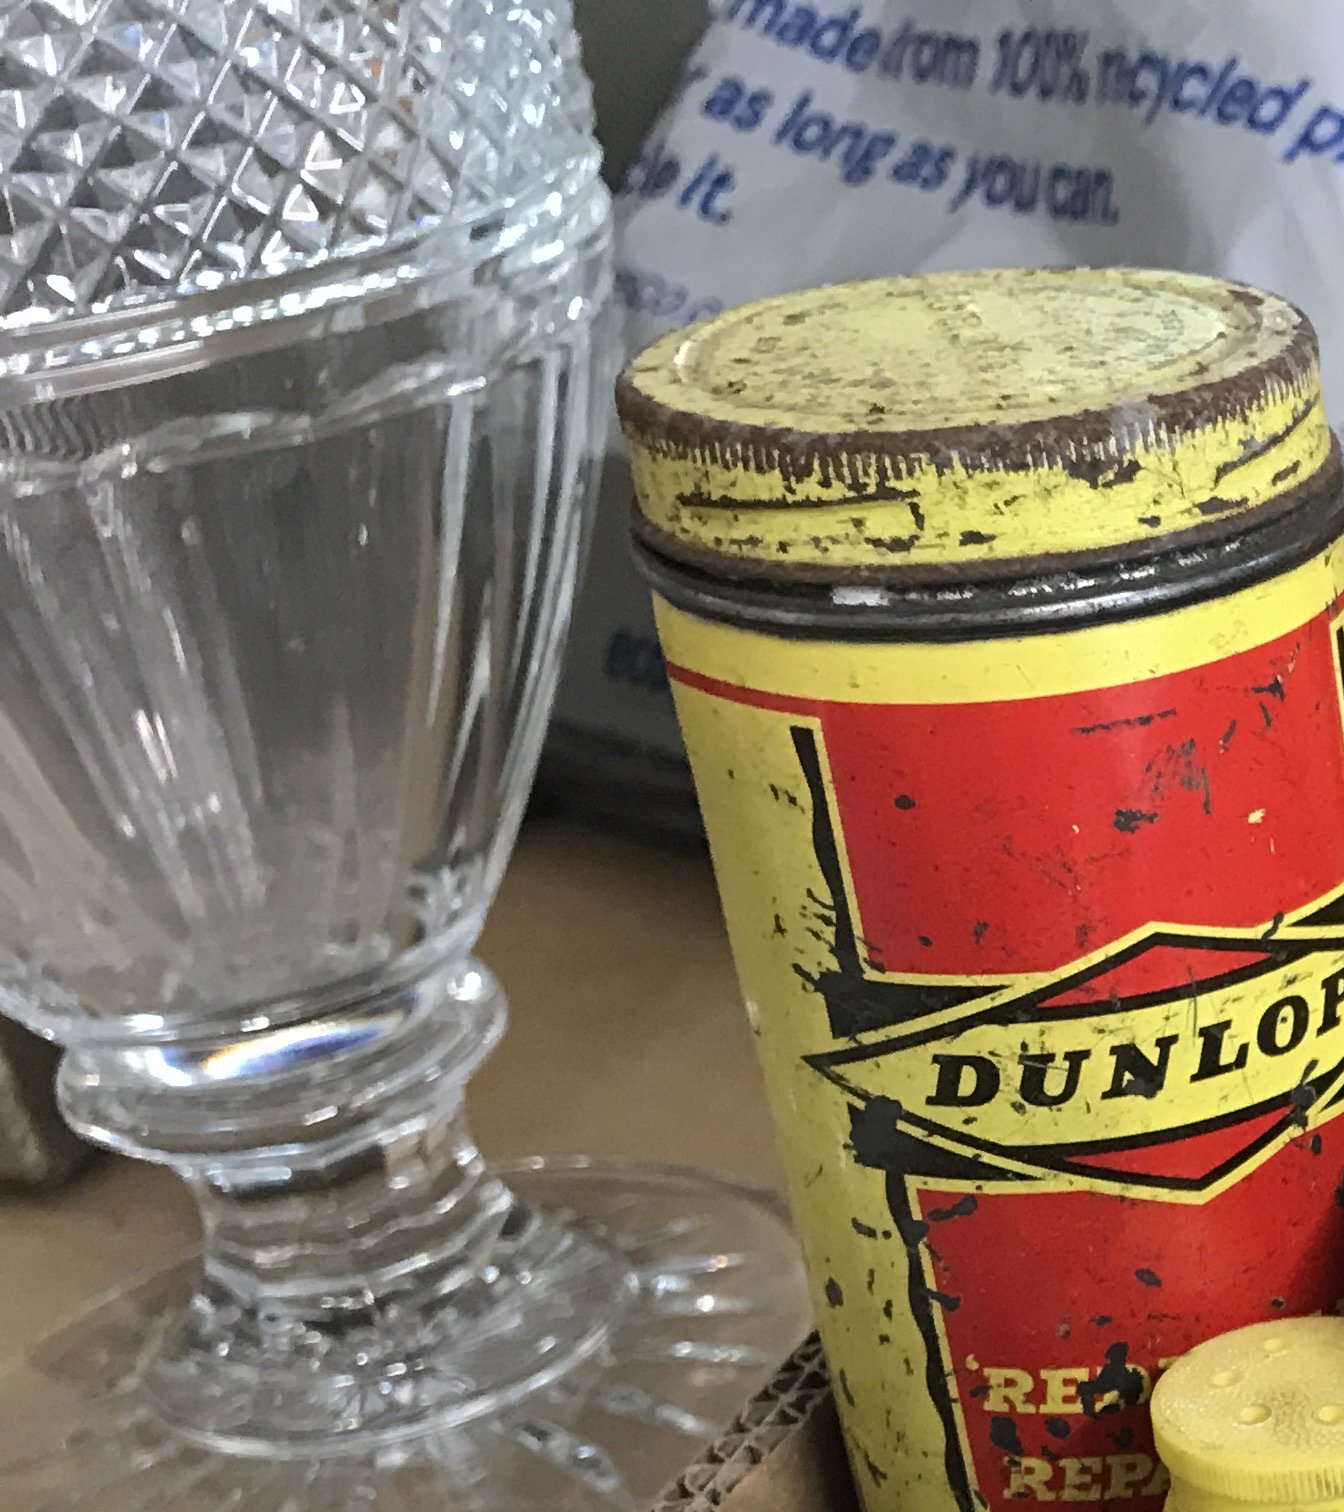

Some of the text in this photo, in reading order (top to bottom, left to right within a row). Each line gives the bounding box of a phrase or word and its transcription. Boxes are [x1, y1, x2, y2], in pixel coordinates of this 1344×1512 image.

[990, 27, 1089, 106] 100%
[679, 154, 734, 226] it.
[702, 75, 1120, 228] as long as you can.
